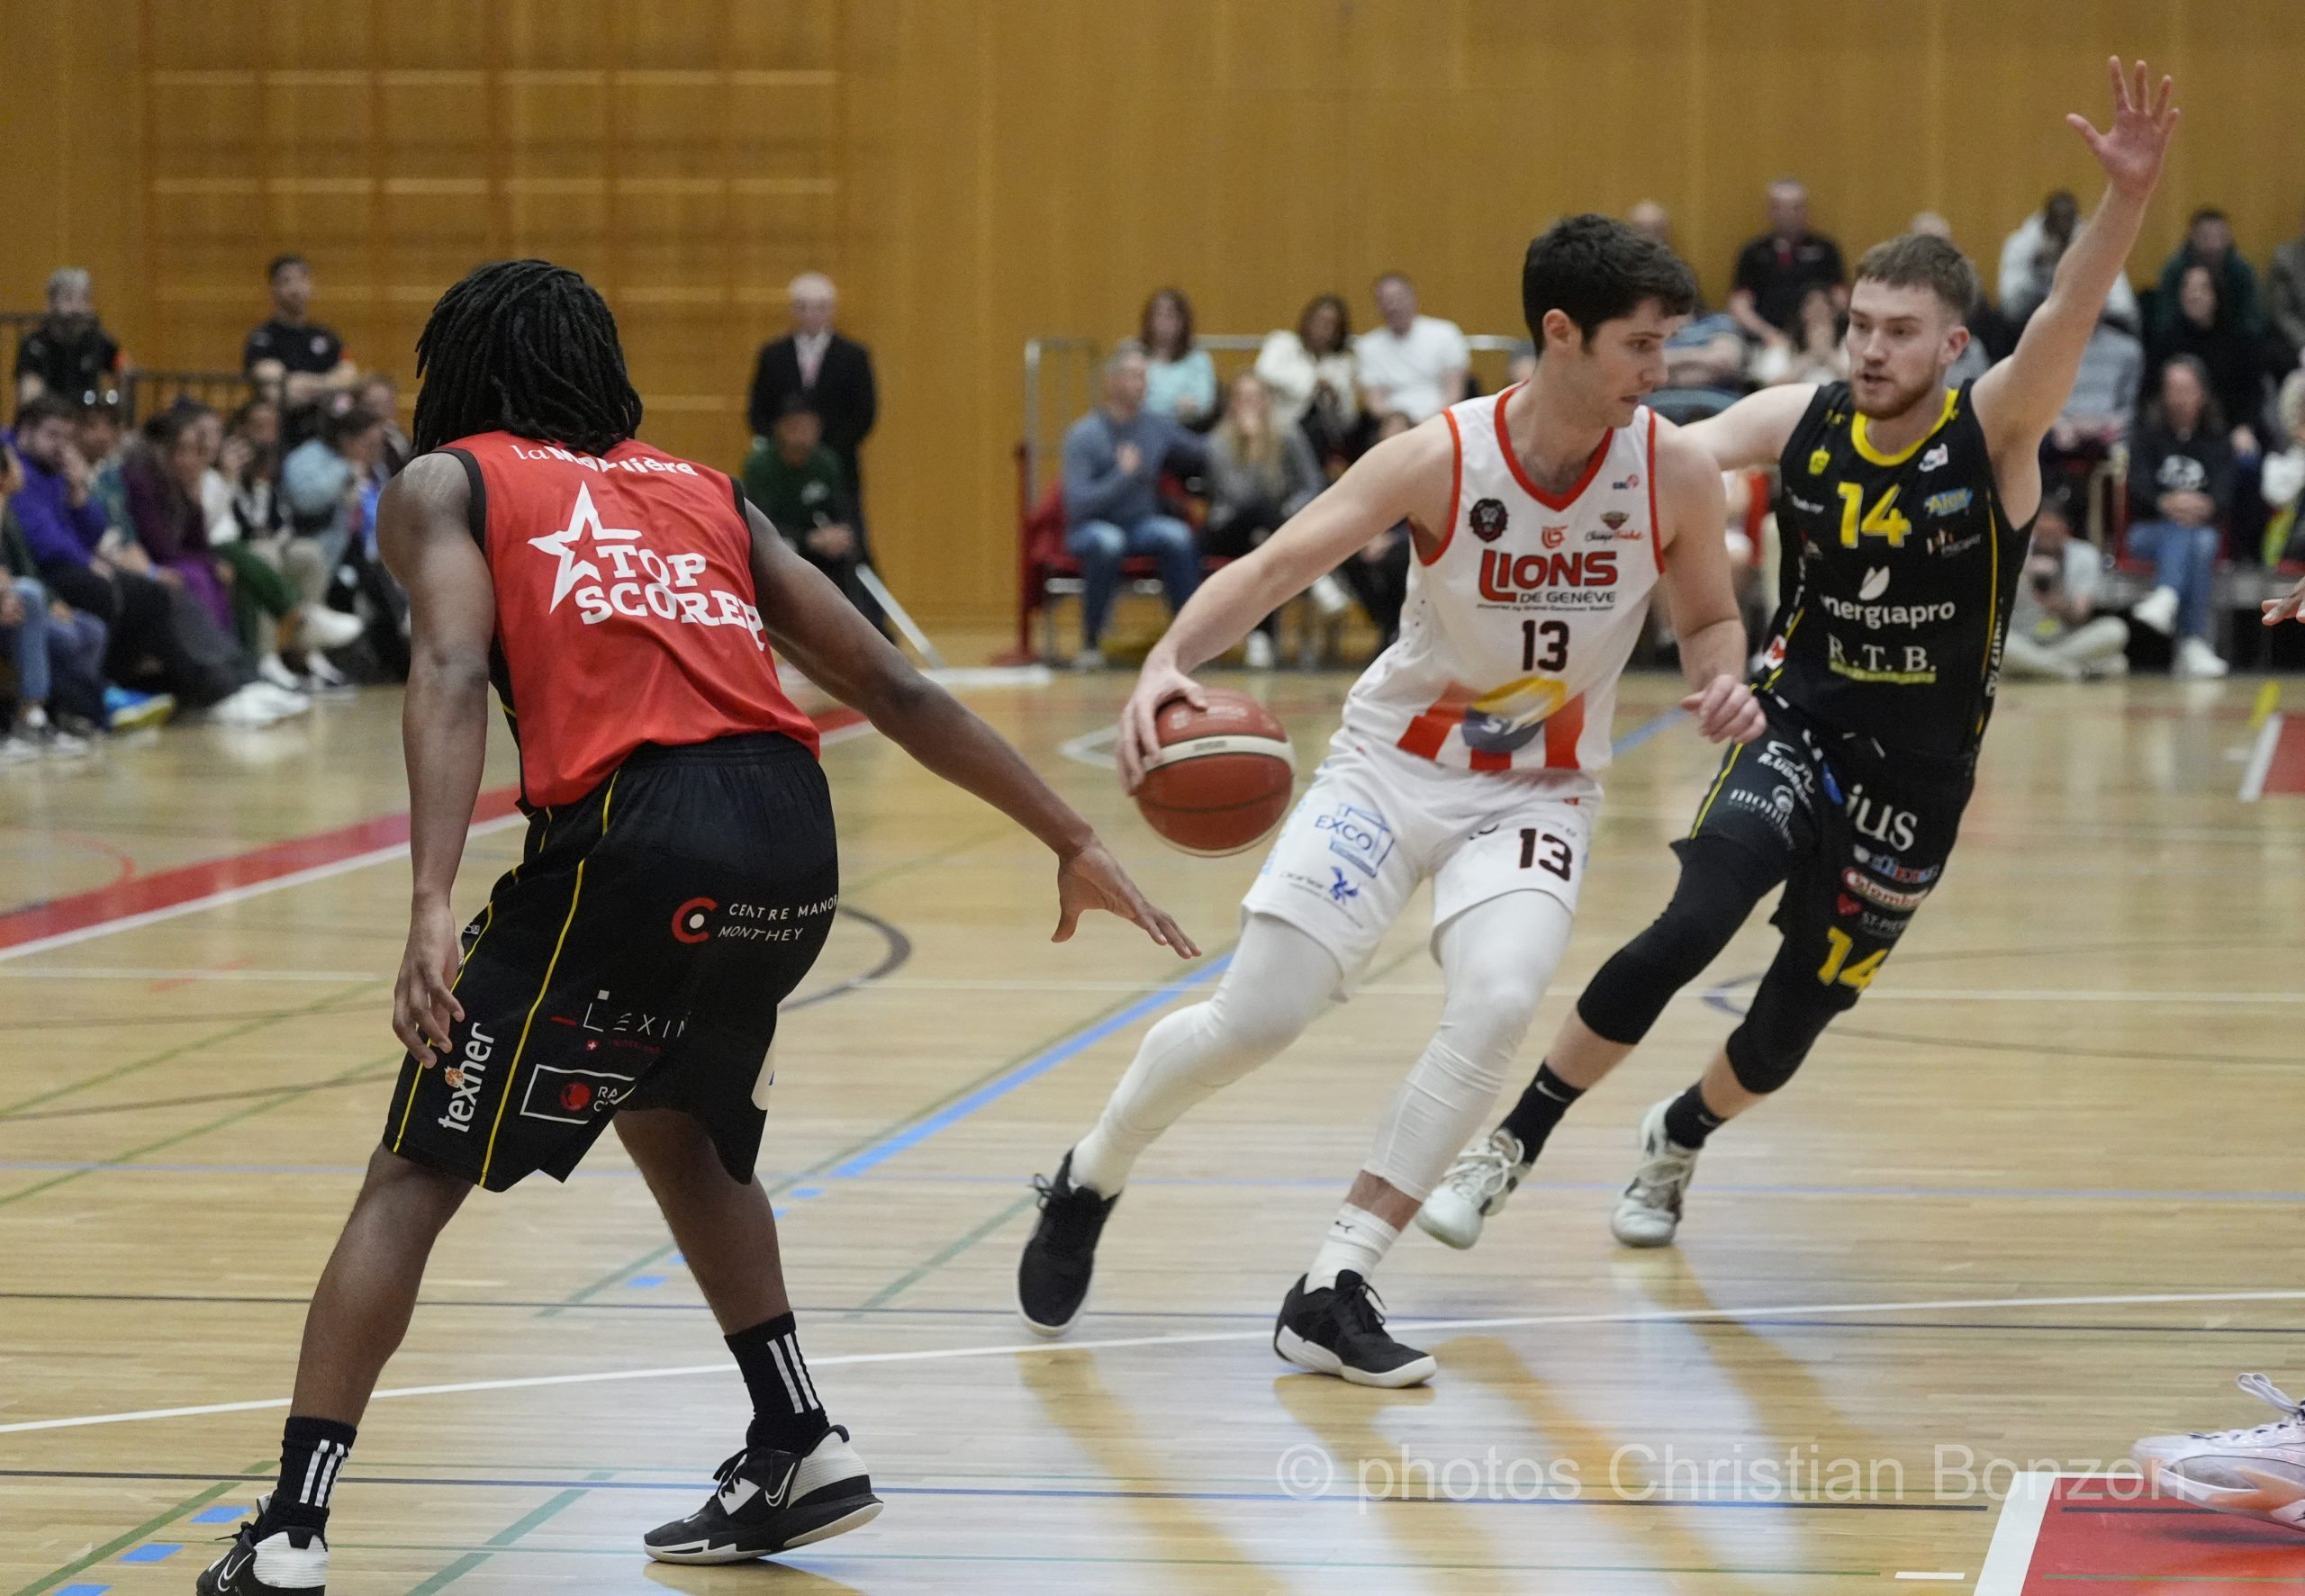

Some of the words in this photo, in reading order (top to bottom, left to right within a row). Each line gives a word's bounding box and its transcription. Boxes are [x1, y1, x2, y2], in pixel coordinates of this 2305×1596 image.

[1837, 481, 1912, 549] 14
[595, 544, 707, 588] TOP
[1478, 548, 1618, 603] LIONS
[1519, 592, 1541, 604] DE
[1523, 620, 1569, 672] 13
[1315, 815, 1373, 852] EXCO
[1519, 828, 1573, 882] 13
[717, 925, 804, 942] MONTHEY
[728, 903, 790, 921] CENTRE
[1817, 925, 1891, 992] 14
[438, 1022, 495, 1133] texner
